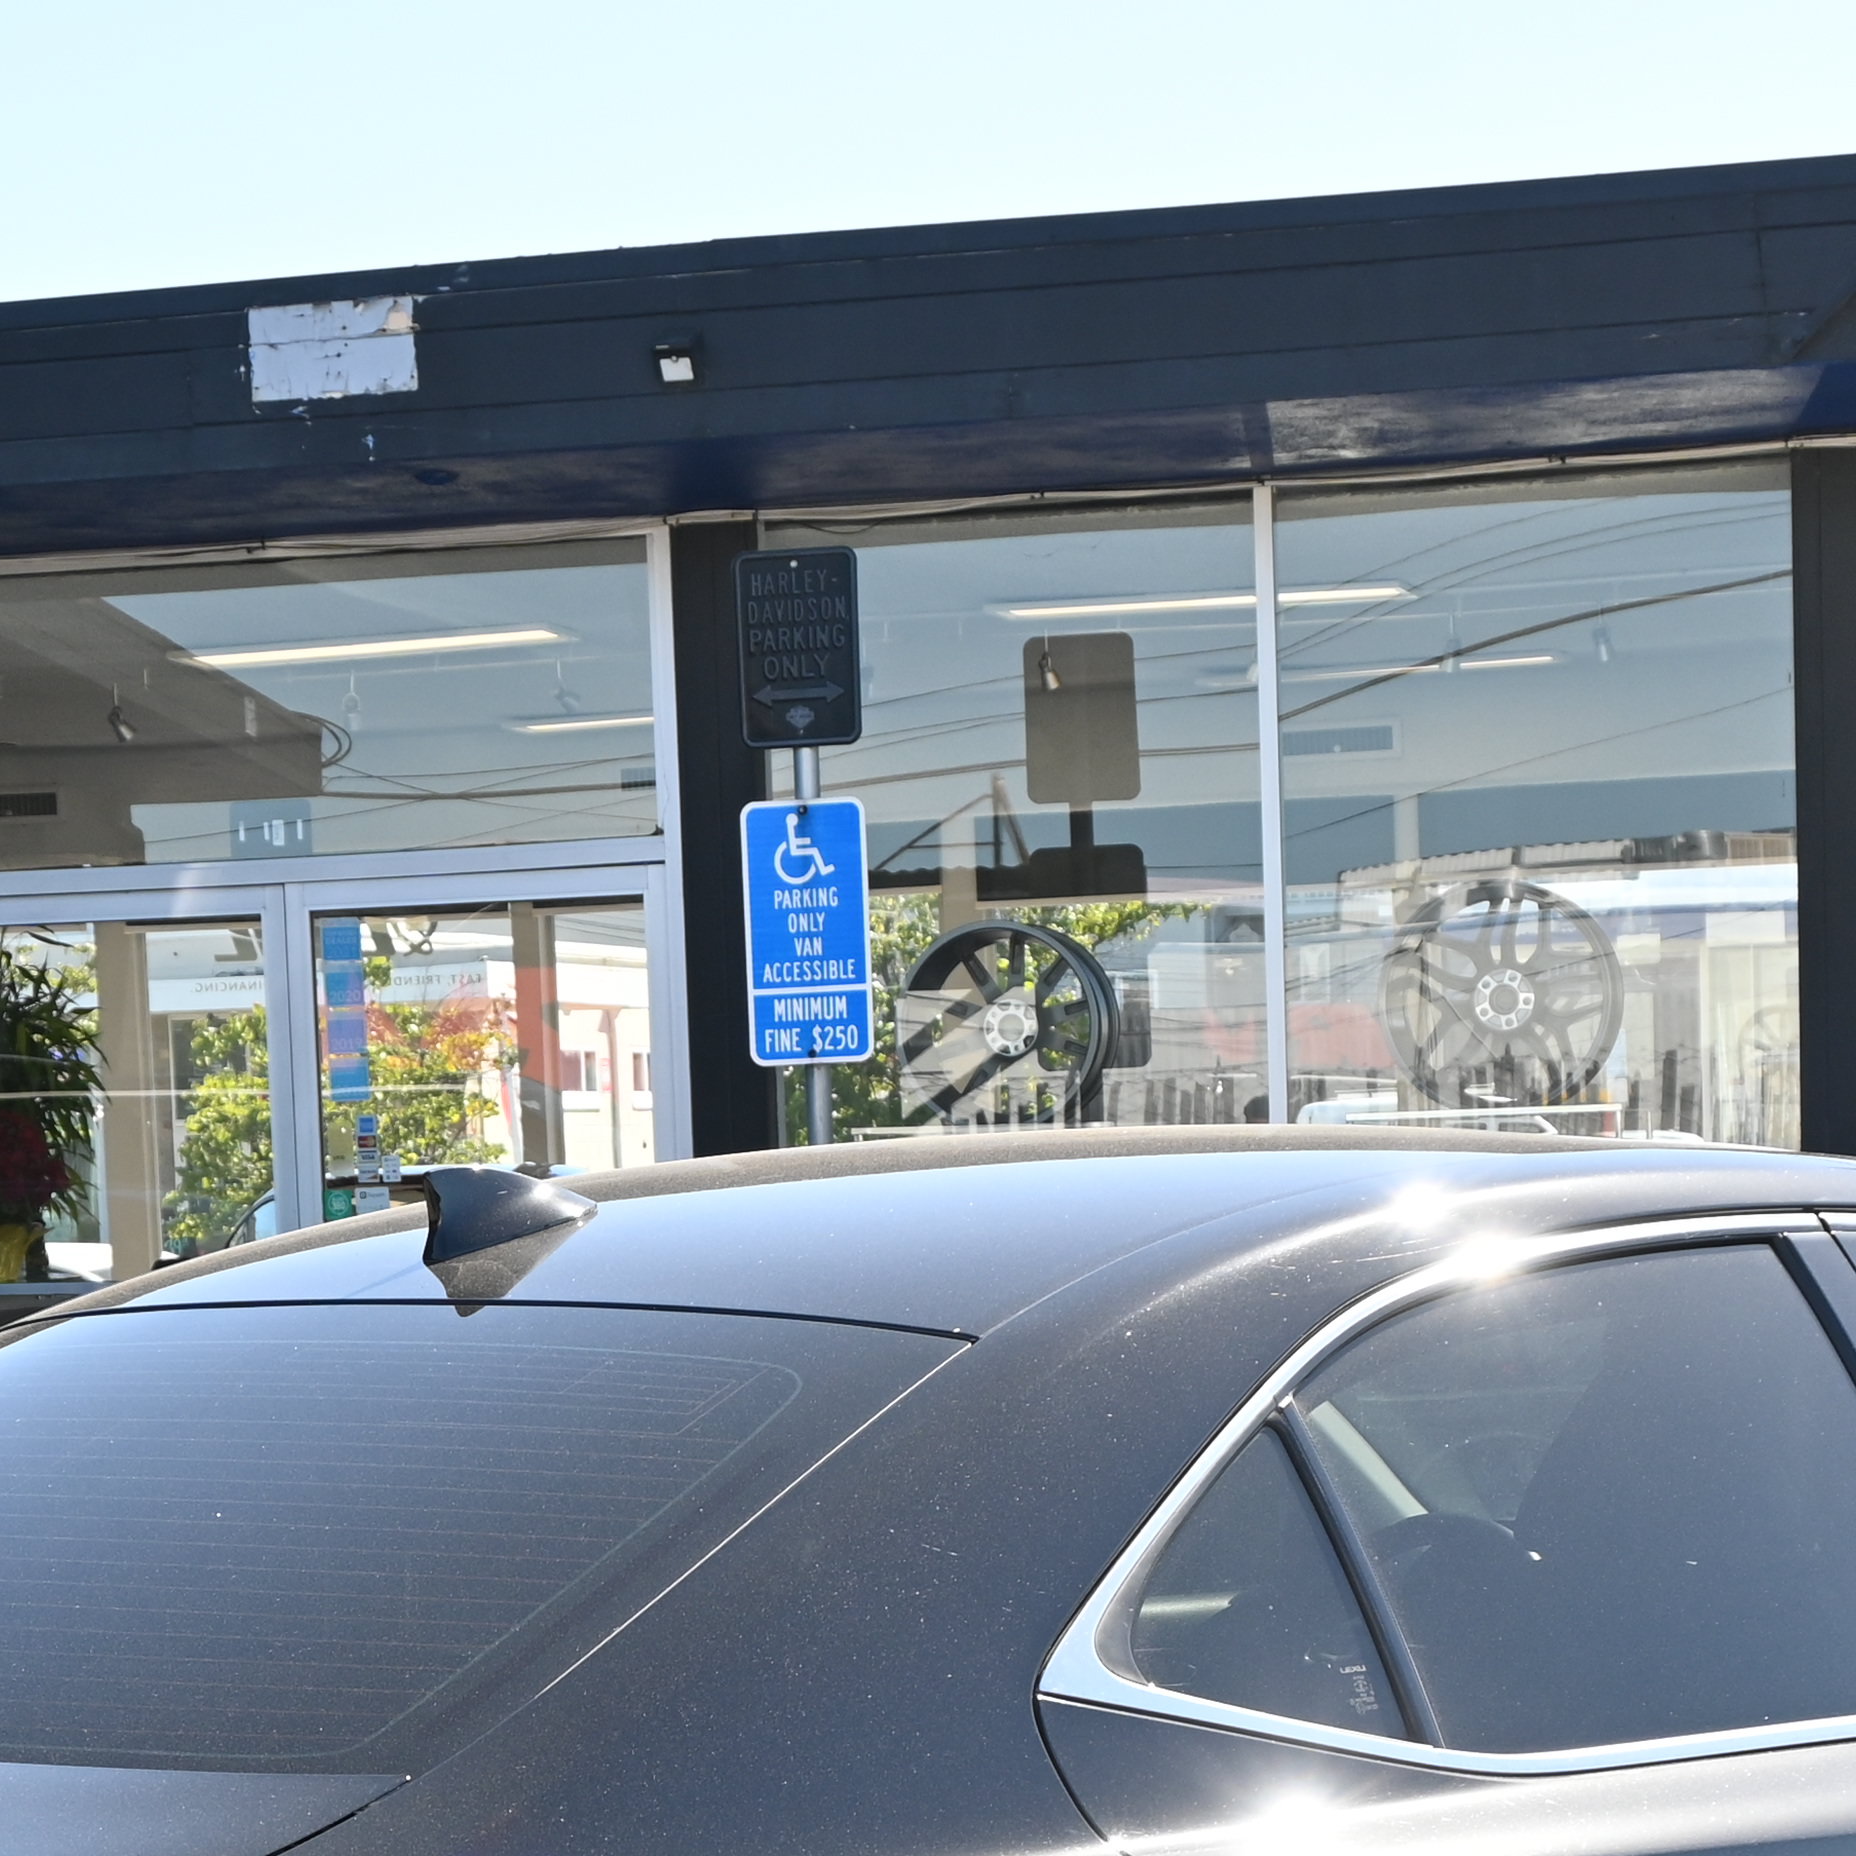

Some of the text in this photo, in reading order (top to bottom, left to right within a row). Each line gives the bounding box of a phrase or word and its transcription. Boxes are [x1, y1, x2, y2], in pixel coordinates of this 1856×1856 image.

[751, 569, 838, 597] HARLEY-
[747, 595, 846, 625] DAVIDSON
[749, 623, 845, 653] PARKING
[764, 653, 830, 680] ONLY
[774, 886, 839, 910] PARKING
[787, 912, 826, 934] ONLY
[793, 936, 823, 957] VAN
[763, 958, 856, 983] ACCESSIBLE
[330, 990, 362, 1002] 2020
[773, 995, 848, 1023] MINIMUM
[764, 1023, 859, 1053] FINE $250
